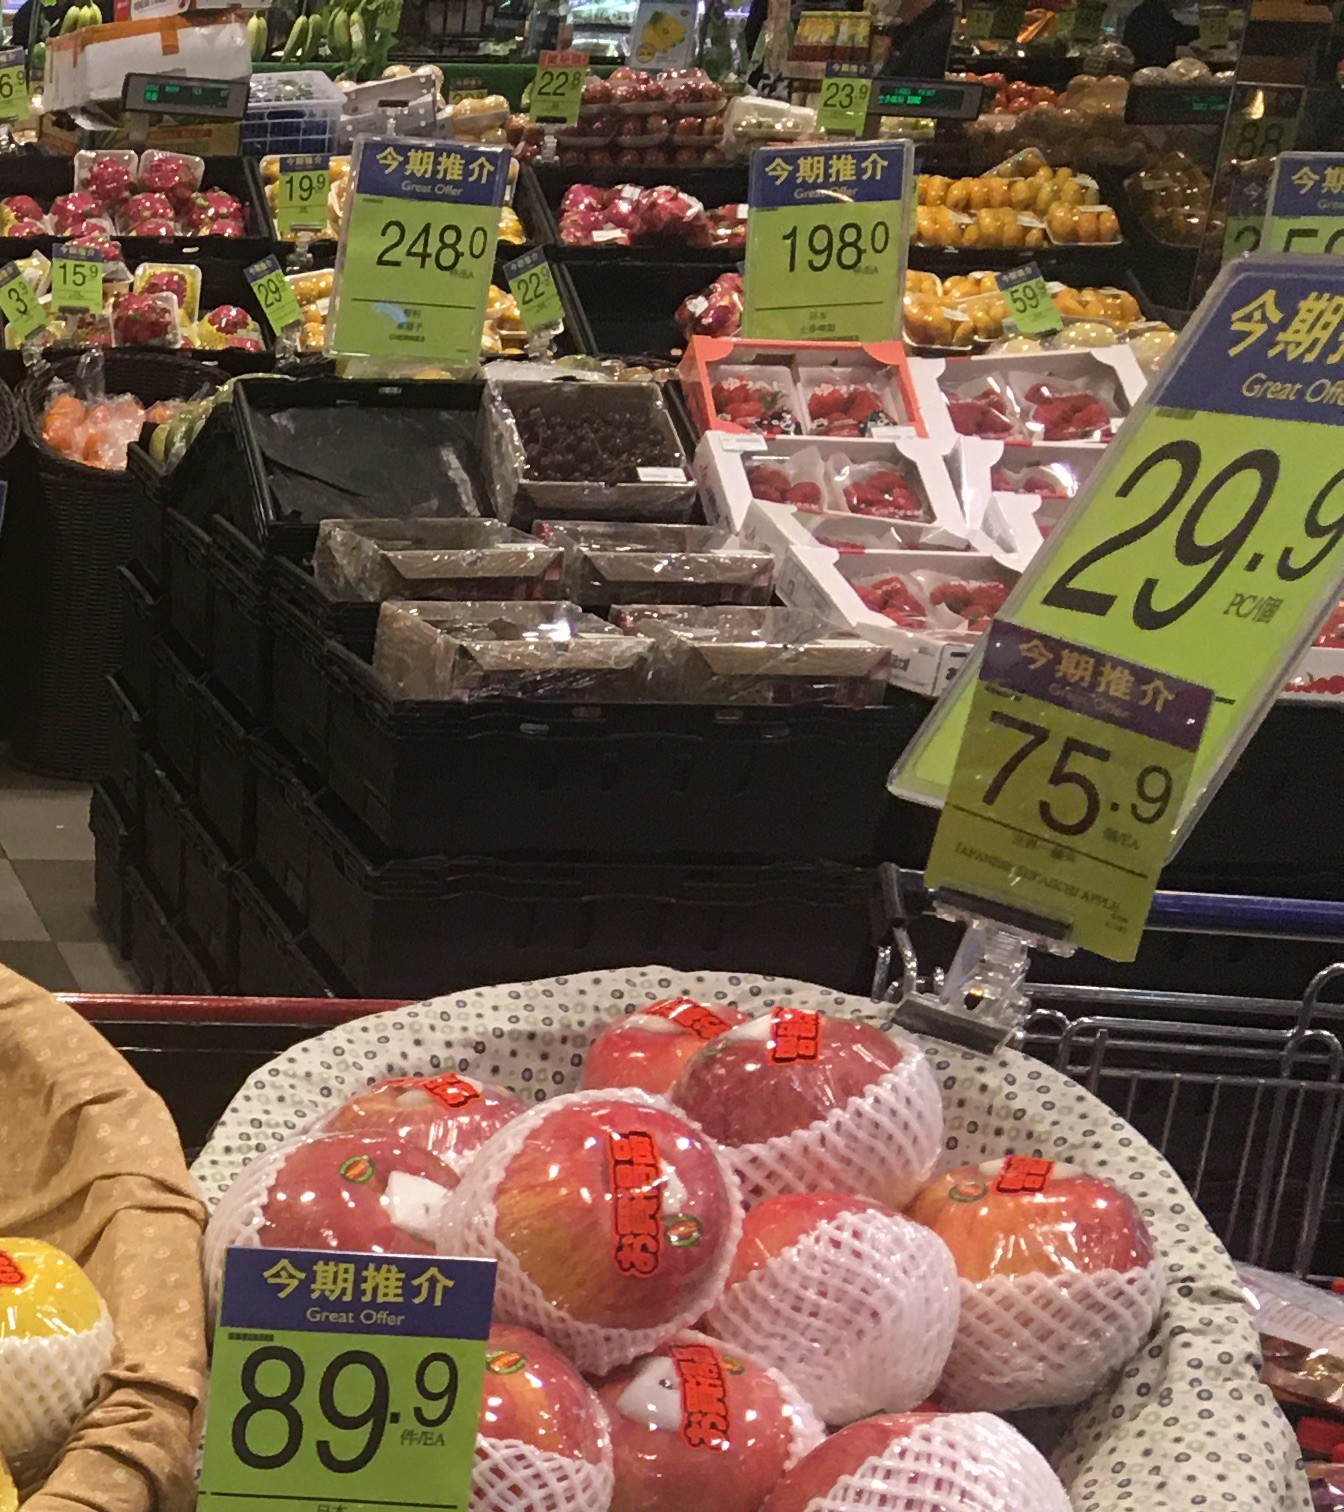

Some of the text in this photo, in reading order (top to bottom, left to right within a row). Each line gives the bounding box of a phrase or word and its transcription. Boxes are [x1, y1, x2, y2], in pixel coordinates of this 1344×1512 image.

[376, 146, 495, 184] 今期推介
[765, 153, 889, 185] 今期推介
[1228, 288, 1344, 365] 今期
[1242, 372, 1302, 401] Great
[1018, 637, 1177, 713] 今期推介
[981, 710, 1174, 837] 75.9
[263, 1257, 455, 1307] 今期推介
[306, 1307, 405, 1327] Great Offer
[231, 1345, 458, 1474] 89.9
